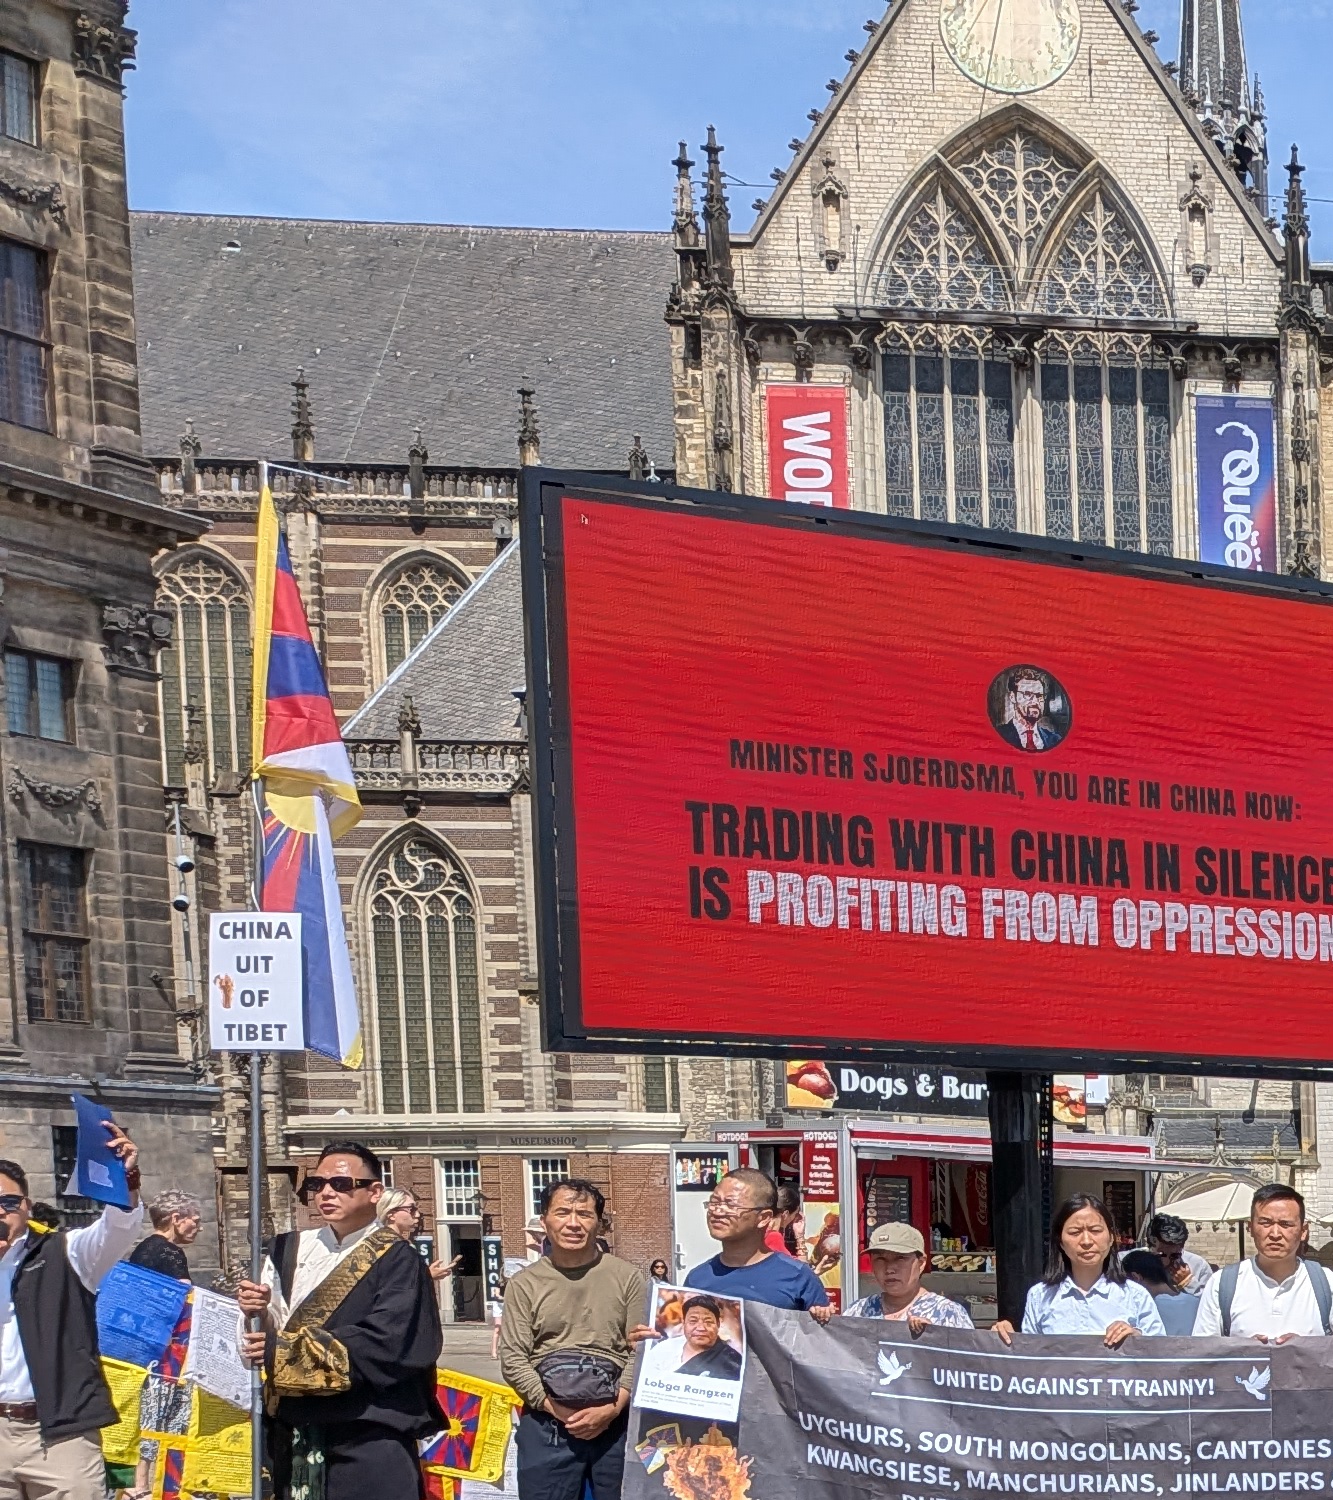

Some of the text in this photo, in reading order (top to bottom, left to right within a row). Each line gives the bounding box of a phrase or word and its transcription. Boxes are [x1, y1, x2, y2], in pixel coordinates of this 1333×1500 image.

[729, 738, 1302, 823] MINISTER SJOERDSMA, YOU ARE IN CHINA NOW:
[685, 800, 875, 868] TRADING
[889, 817, 996, 878] WITH
[1010, 829, 1130, 890] CHINA
[1143, 841, 1181, 893] IN
[688, 865, 731, 921] IS
[746, 869, 968, 938] PROFITING
[981, 887, 1100, 947] FROM
[218, 921, 293, 940] CHINA
[235, 955, 274, 974] UIT
[239, 989, 270, 1008] OF
[223, 1023, 288, 1042] TIBET
[840, 1067, 909, 1100] Dogs
[915, 1073, 935, 1097] &
[510, 1136, 578, 1146] MUSEUMSHOP
[644, 1377, 681, 1392] Lobga
[683, 1384, 735, 1400] Rangzen
[932, 1367, 1215, 1397] UNITED AGAINST TYRANNY!
[797, 1411, 912, 1454] UYGHURS,
[917, 1431, 1002, 1459] SOUTH
[1008, 1440, 1192, 1465] MONGOLIANS,
[807, 1443, 961, 1492] KWANGSIESE,
[966, 1469, 1165, 1497] MANCHURIANS,
[1169, 1471, 1325, 1493] JINLANDERS
